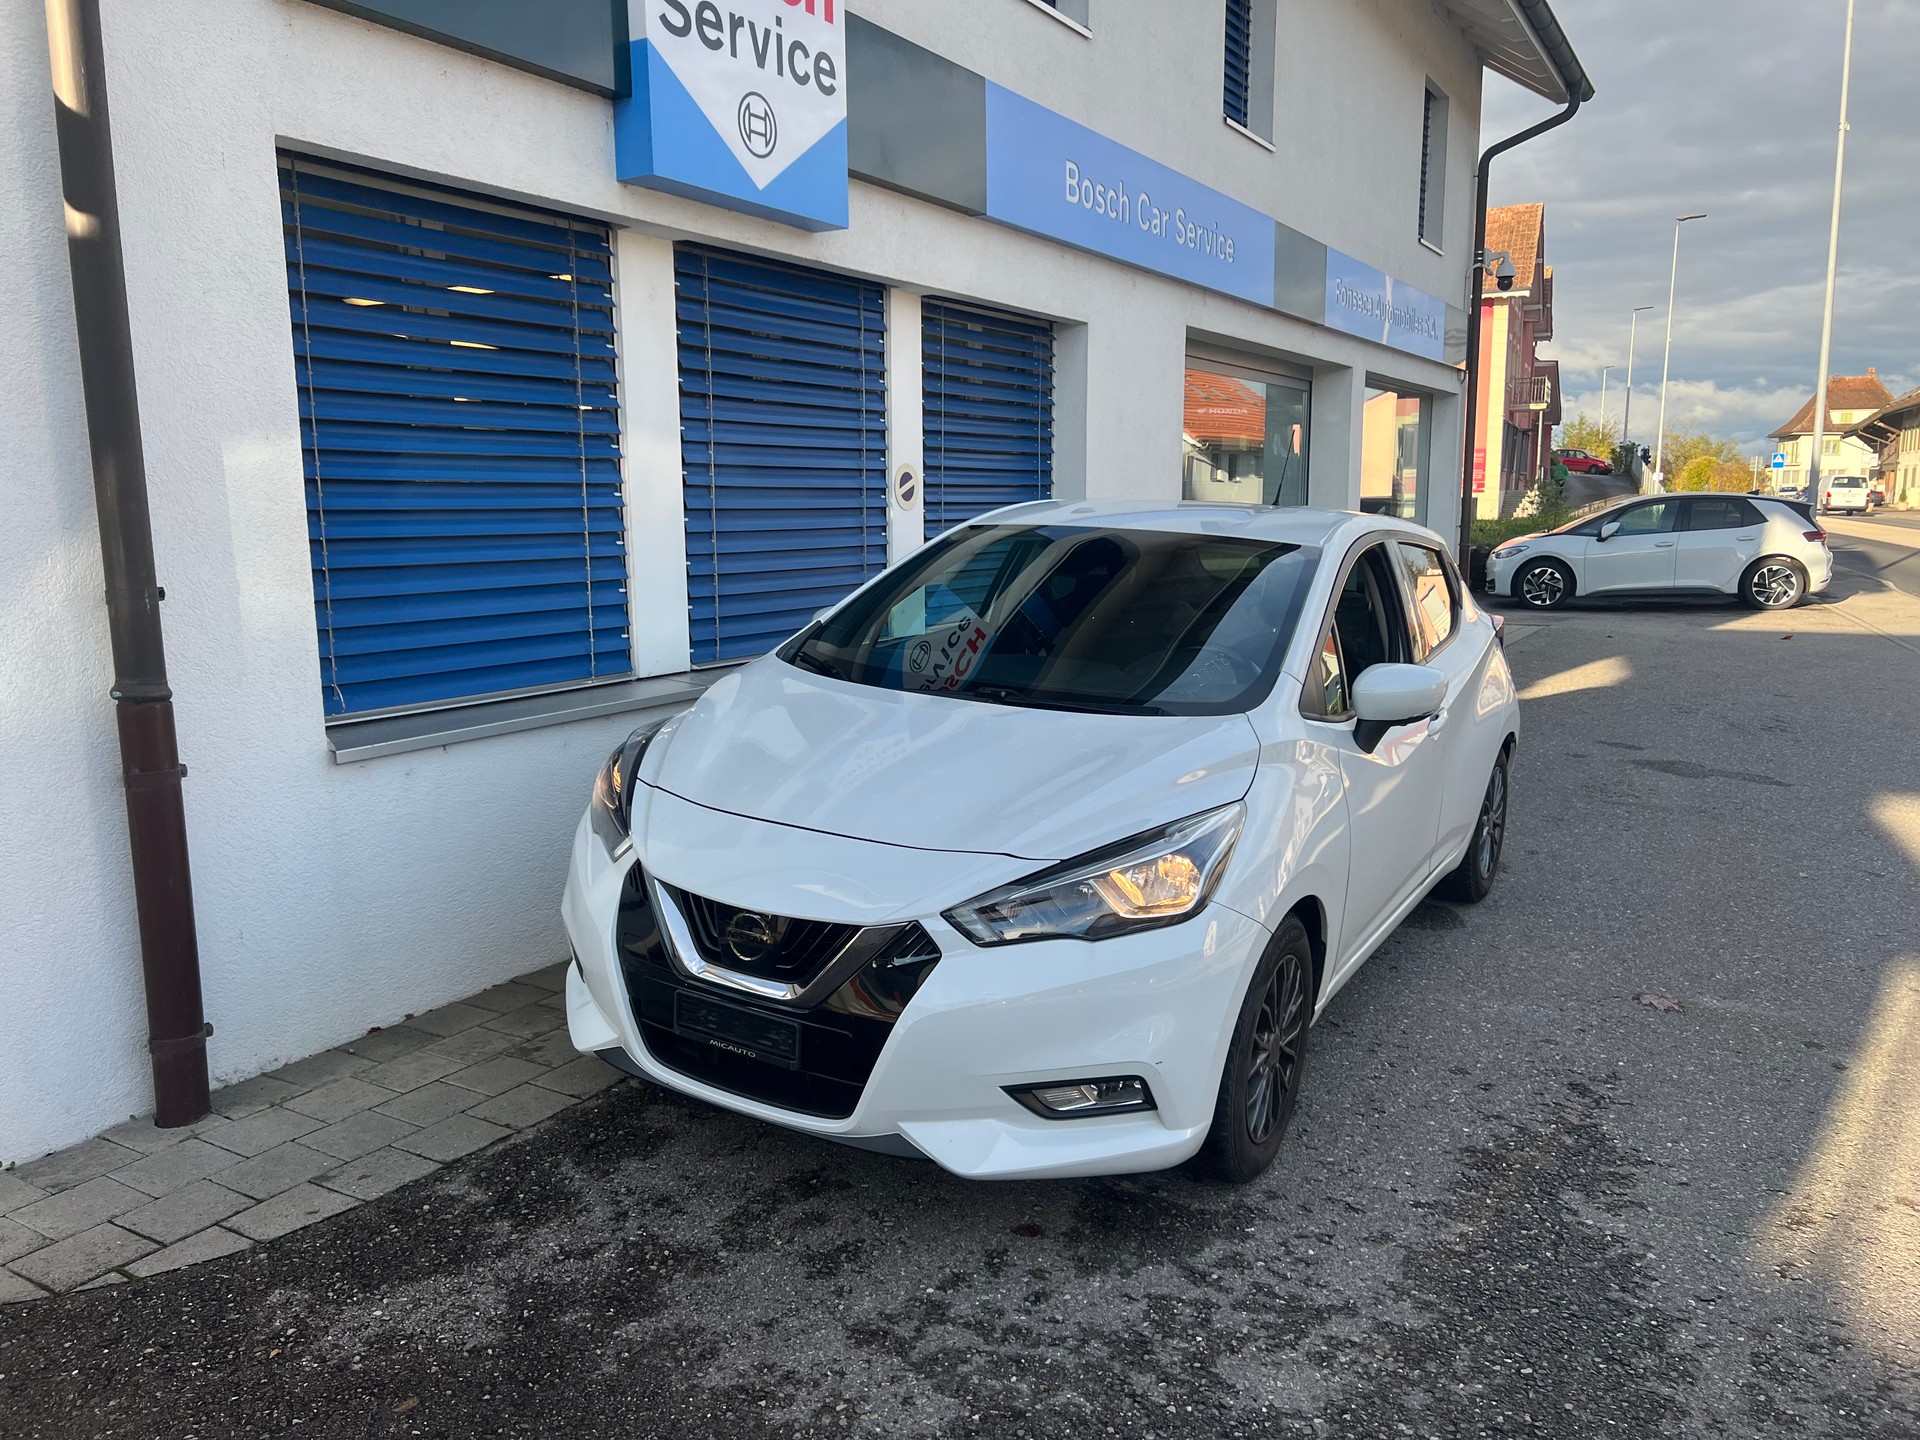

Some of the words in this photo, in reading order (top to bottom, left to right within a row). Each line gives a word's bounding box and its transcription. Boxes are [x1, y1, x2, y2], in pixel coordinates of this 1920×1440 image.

[1065, 159, 1131, 225] Bosch
[1137, 191, 1171, 239] Car
[1175, 207, 1236, 265] Service
[1335, 276, 1374, 317] Fonseca
[1375, 294, 1424, 336] Automobiles
[709, 1039, 756, 1058] MICAUTO
